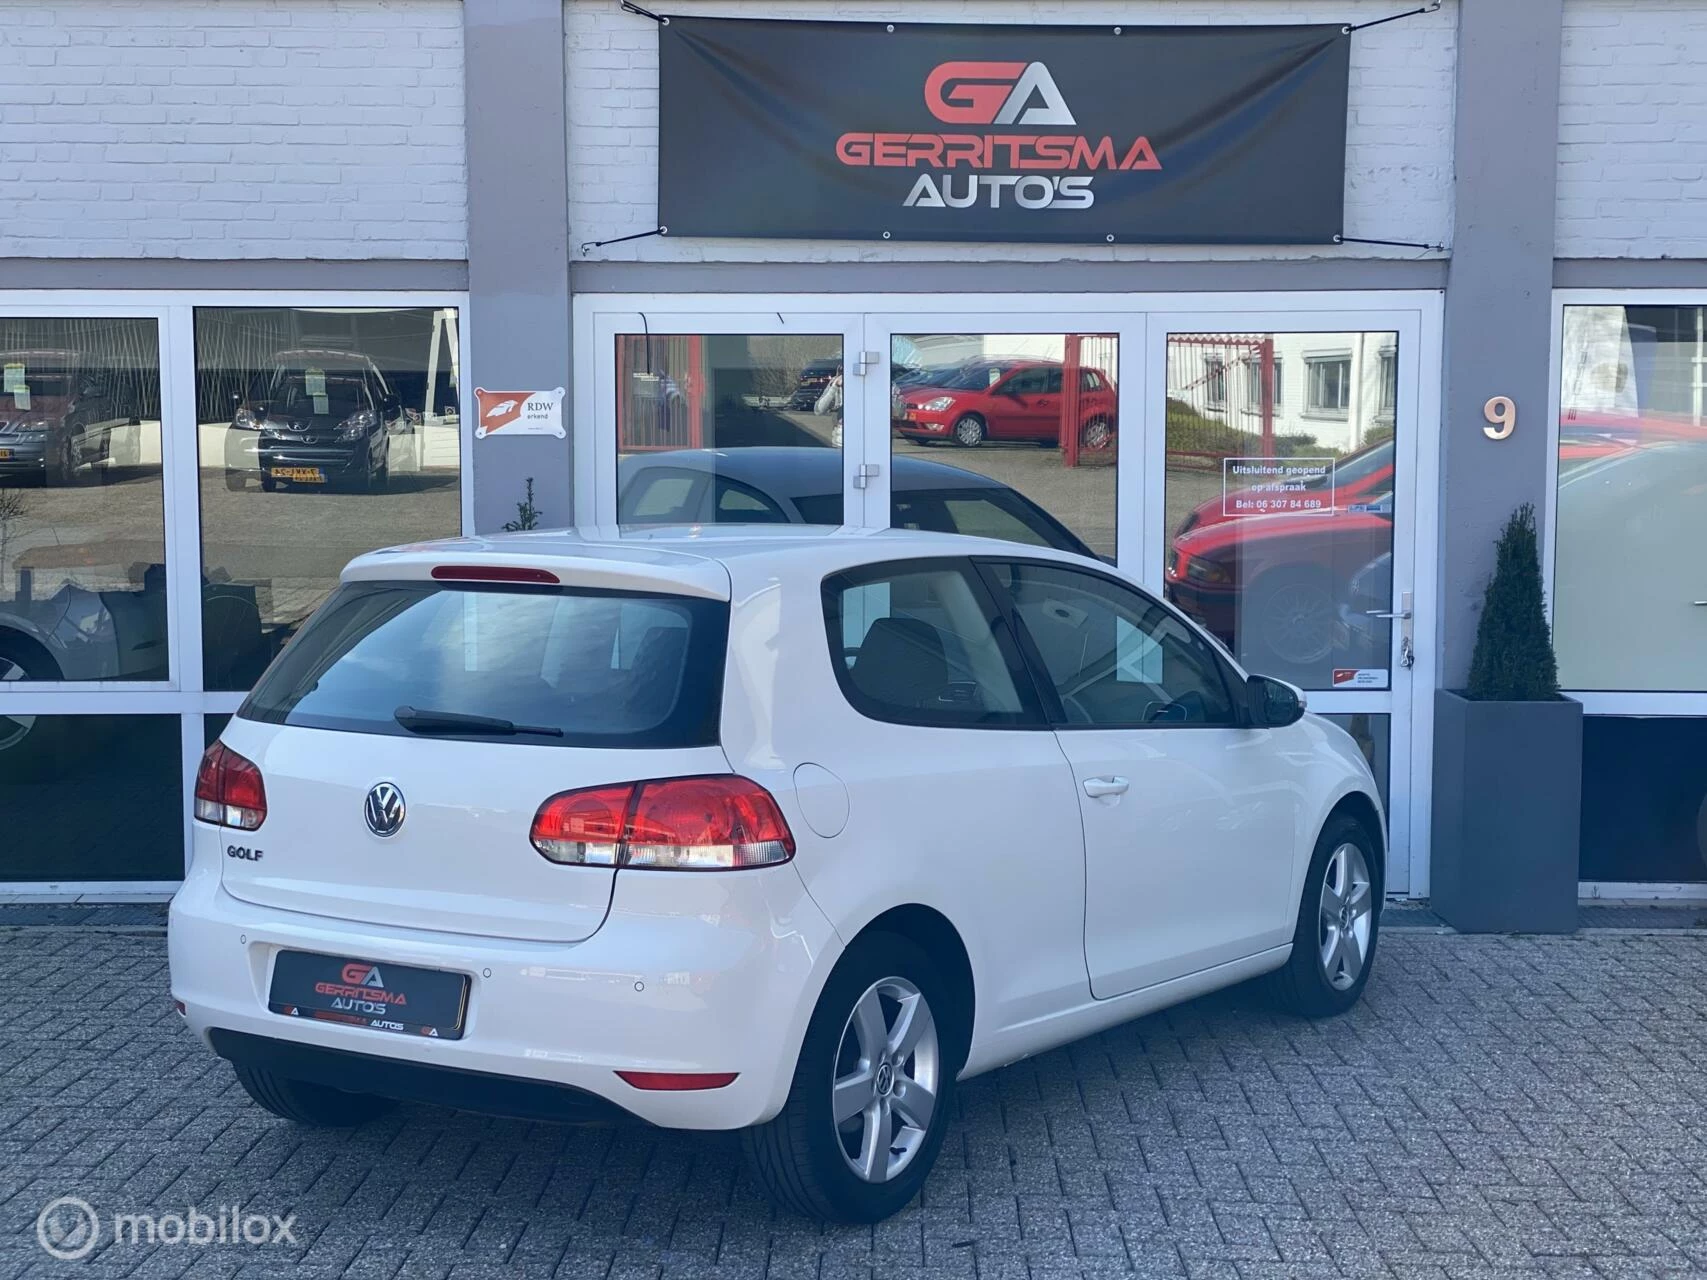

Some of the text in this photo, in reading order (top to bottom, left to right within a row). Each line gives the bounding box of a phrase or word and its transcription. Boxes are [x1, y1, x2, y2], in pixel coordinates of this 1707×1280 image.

[924, 61, 1077, 125] GA
[835, 132, 1163, 171] GERRITSMA
[902, 173, 1094, 210] AUTO'S
[527, 402, 553, 412] RDW
[1483, 396, 1516, 440] 9
[1232, 465, 1326, 477] Uitsluitend geopend
[1251, 480, 1306, 493] op afspraak
[1236, 499, 1322, 509] Bel: 06 307 84 689
[227, 845, 264, 862] GOLF
[315, 982, 407, 1005] GERRITSMA
